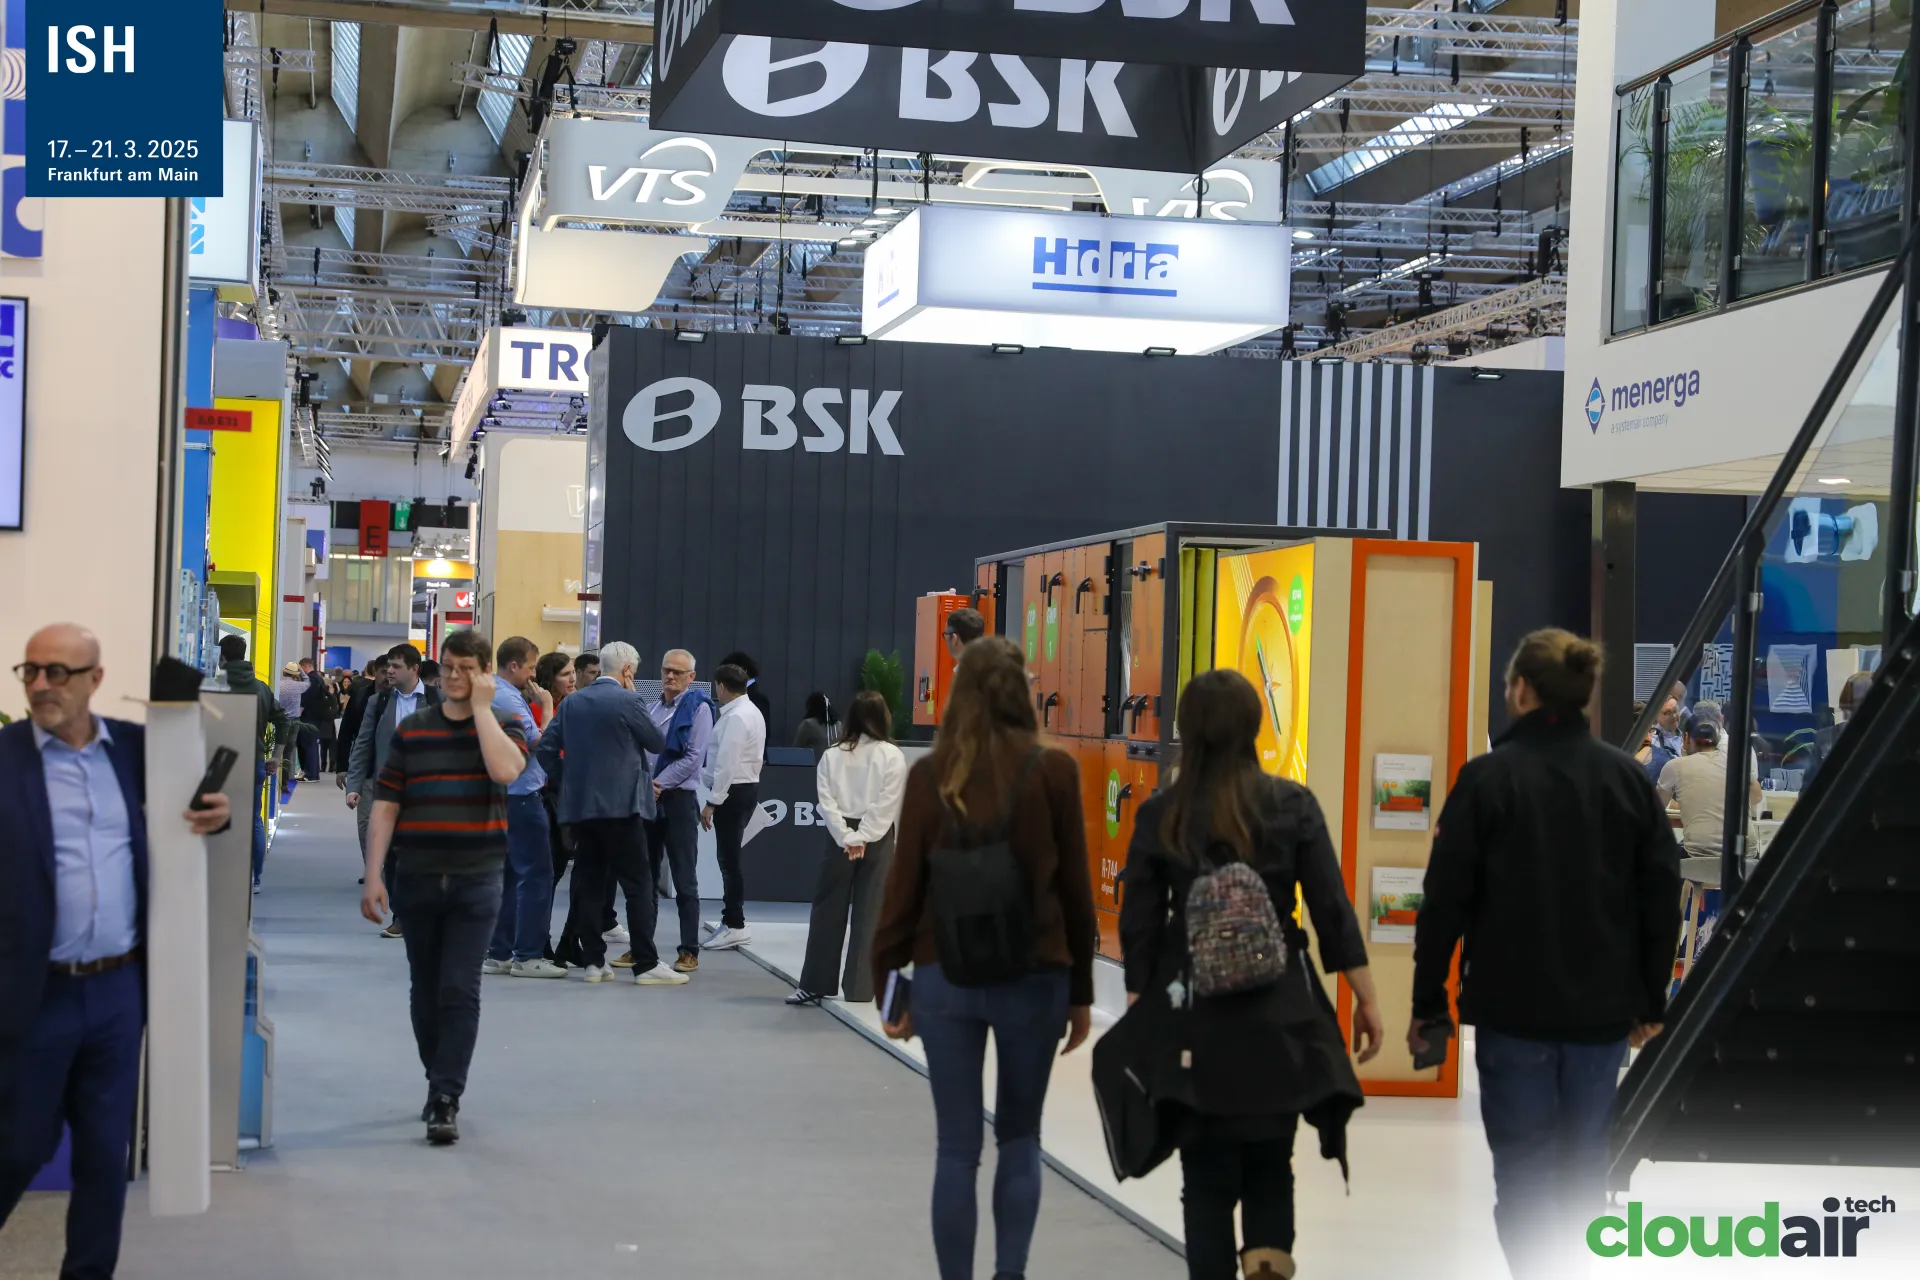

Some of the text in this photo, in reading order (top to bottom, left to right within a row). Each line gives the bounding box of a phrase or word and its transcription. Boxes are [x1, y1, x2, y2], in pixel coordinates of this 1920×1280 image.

[588, 165, 711, 206] VTS
[1032, 235, 1180, 281] Hidria
[1611, 369, 1700, 411] menerga
[741, 384, 905, 456] BSK
[1642, 413, 1669, 429] company
[365, 525, 382, 549] E
